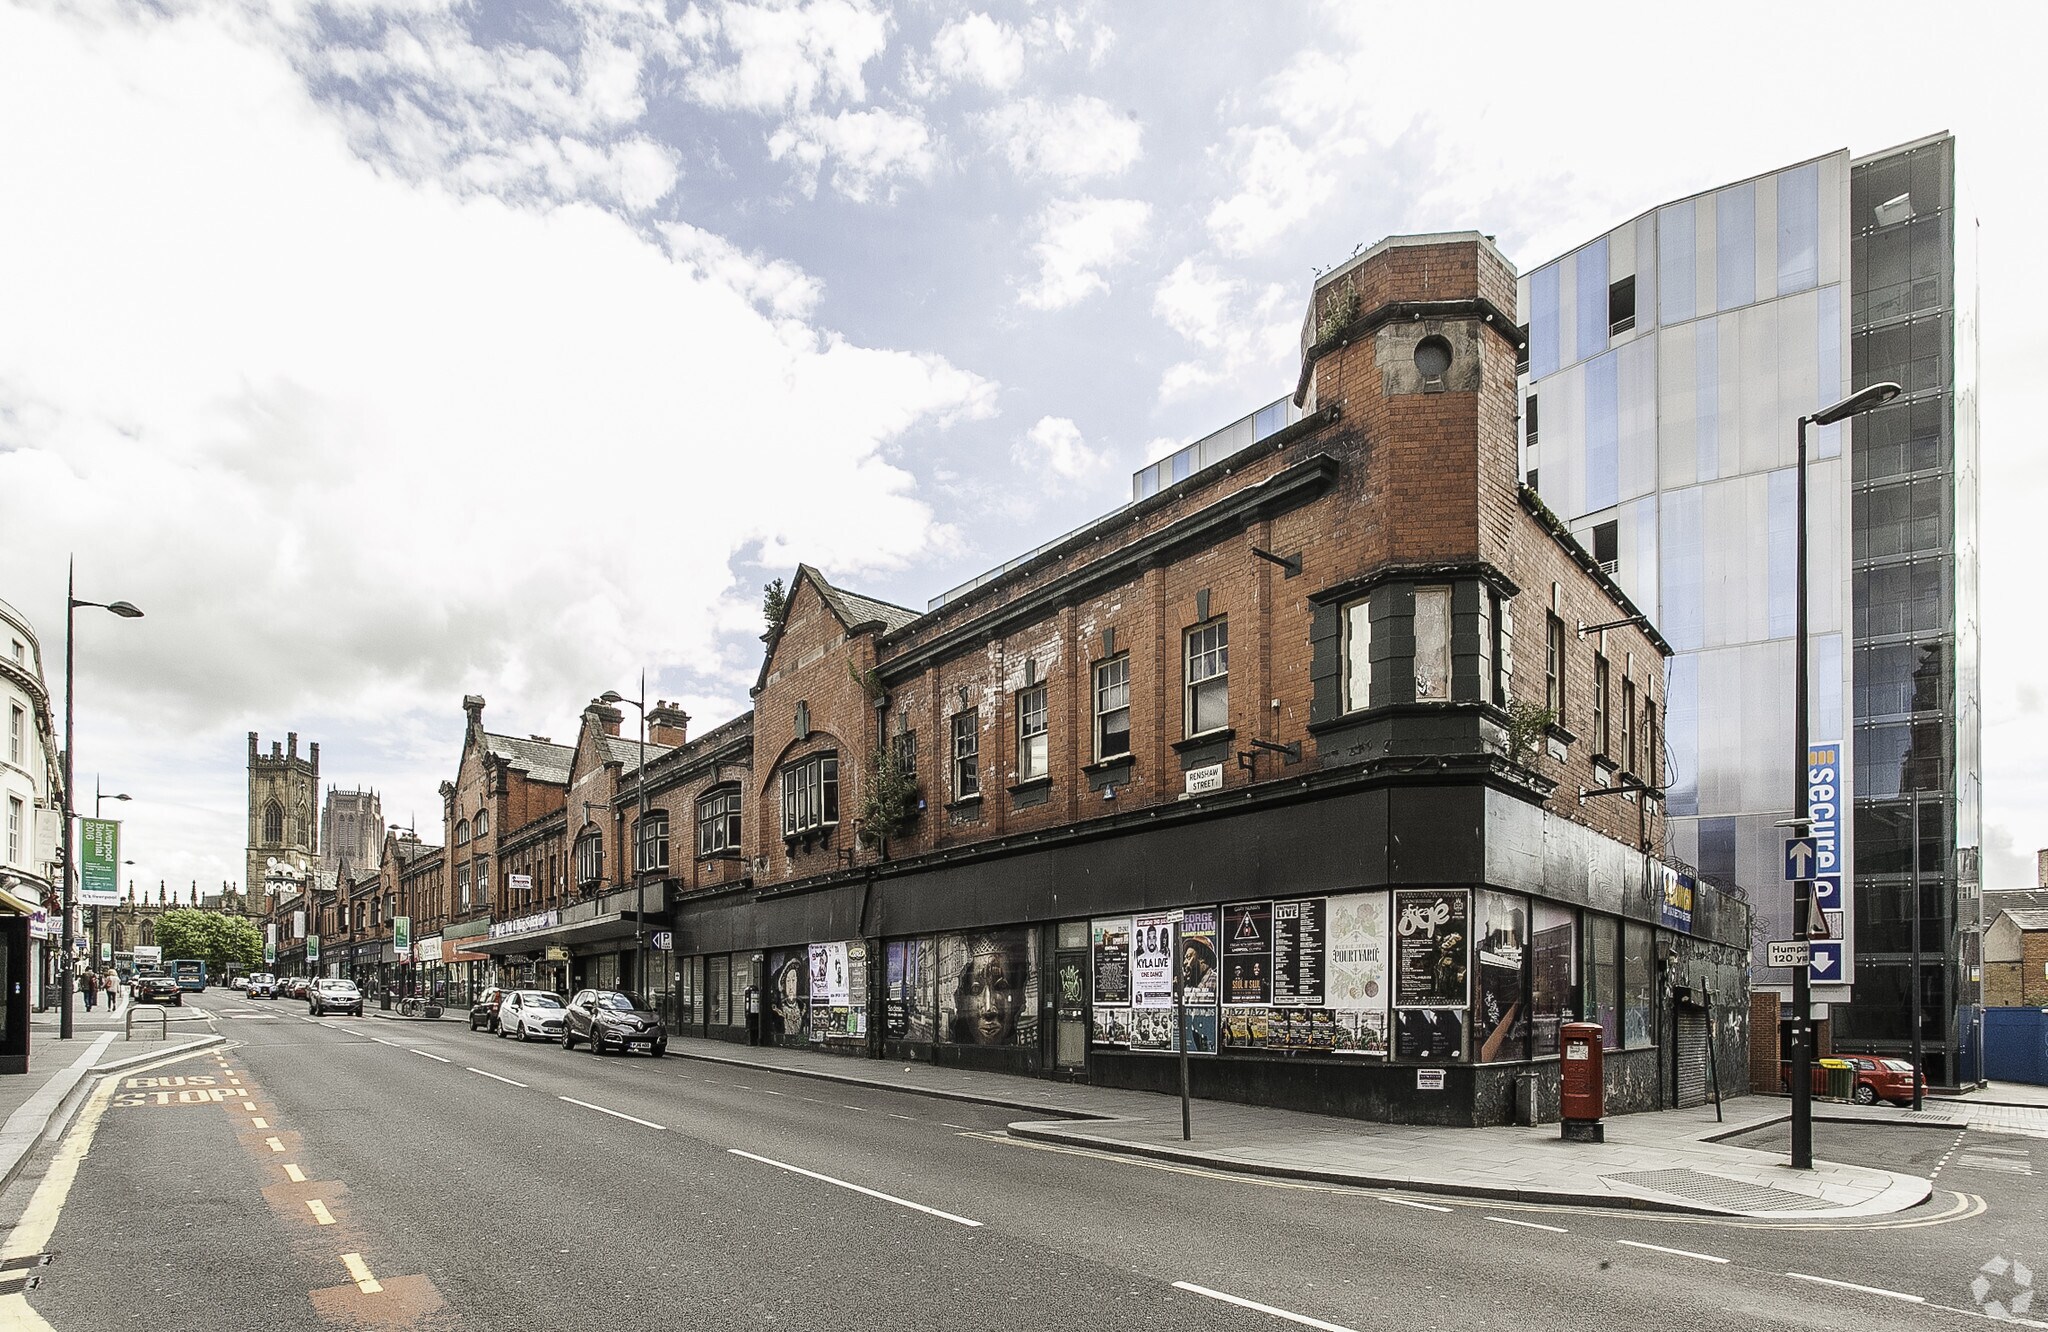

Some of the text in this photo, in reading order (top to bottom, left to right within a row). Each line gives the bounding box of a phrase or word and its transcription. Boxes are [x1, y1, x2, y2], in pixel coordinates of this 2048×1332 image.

[1189, 768, 1218, 781] RENSHAW
[1193, 779, 1214, 790] STREET
[1809, 767, 1835, 868] secure
[85, 821, 95, 841] 2016
[95, 823, 105, 857] Biennial
[104, 823, 115, 862] Liverpool
[1184, 912, 1213, 923] EORGE
[1276, 909, 1297, 918] LIVE
[1180, 921, 1216, 932] LINTON
[663, 932, 670, 942] P
[1136, 957, 1169, 969] KYLA LIVE
[1774, 954, 1793, 963] 120
[126, 1076, 216, 1089] BUS
[113, 1089, 238, 1107] STOP
